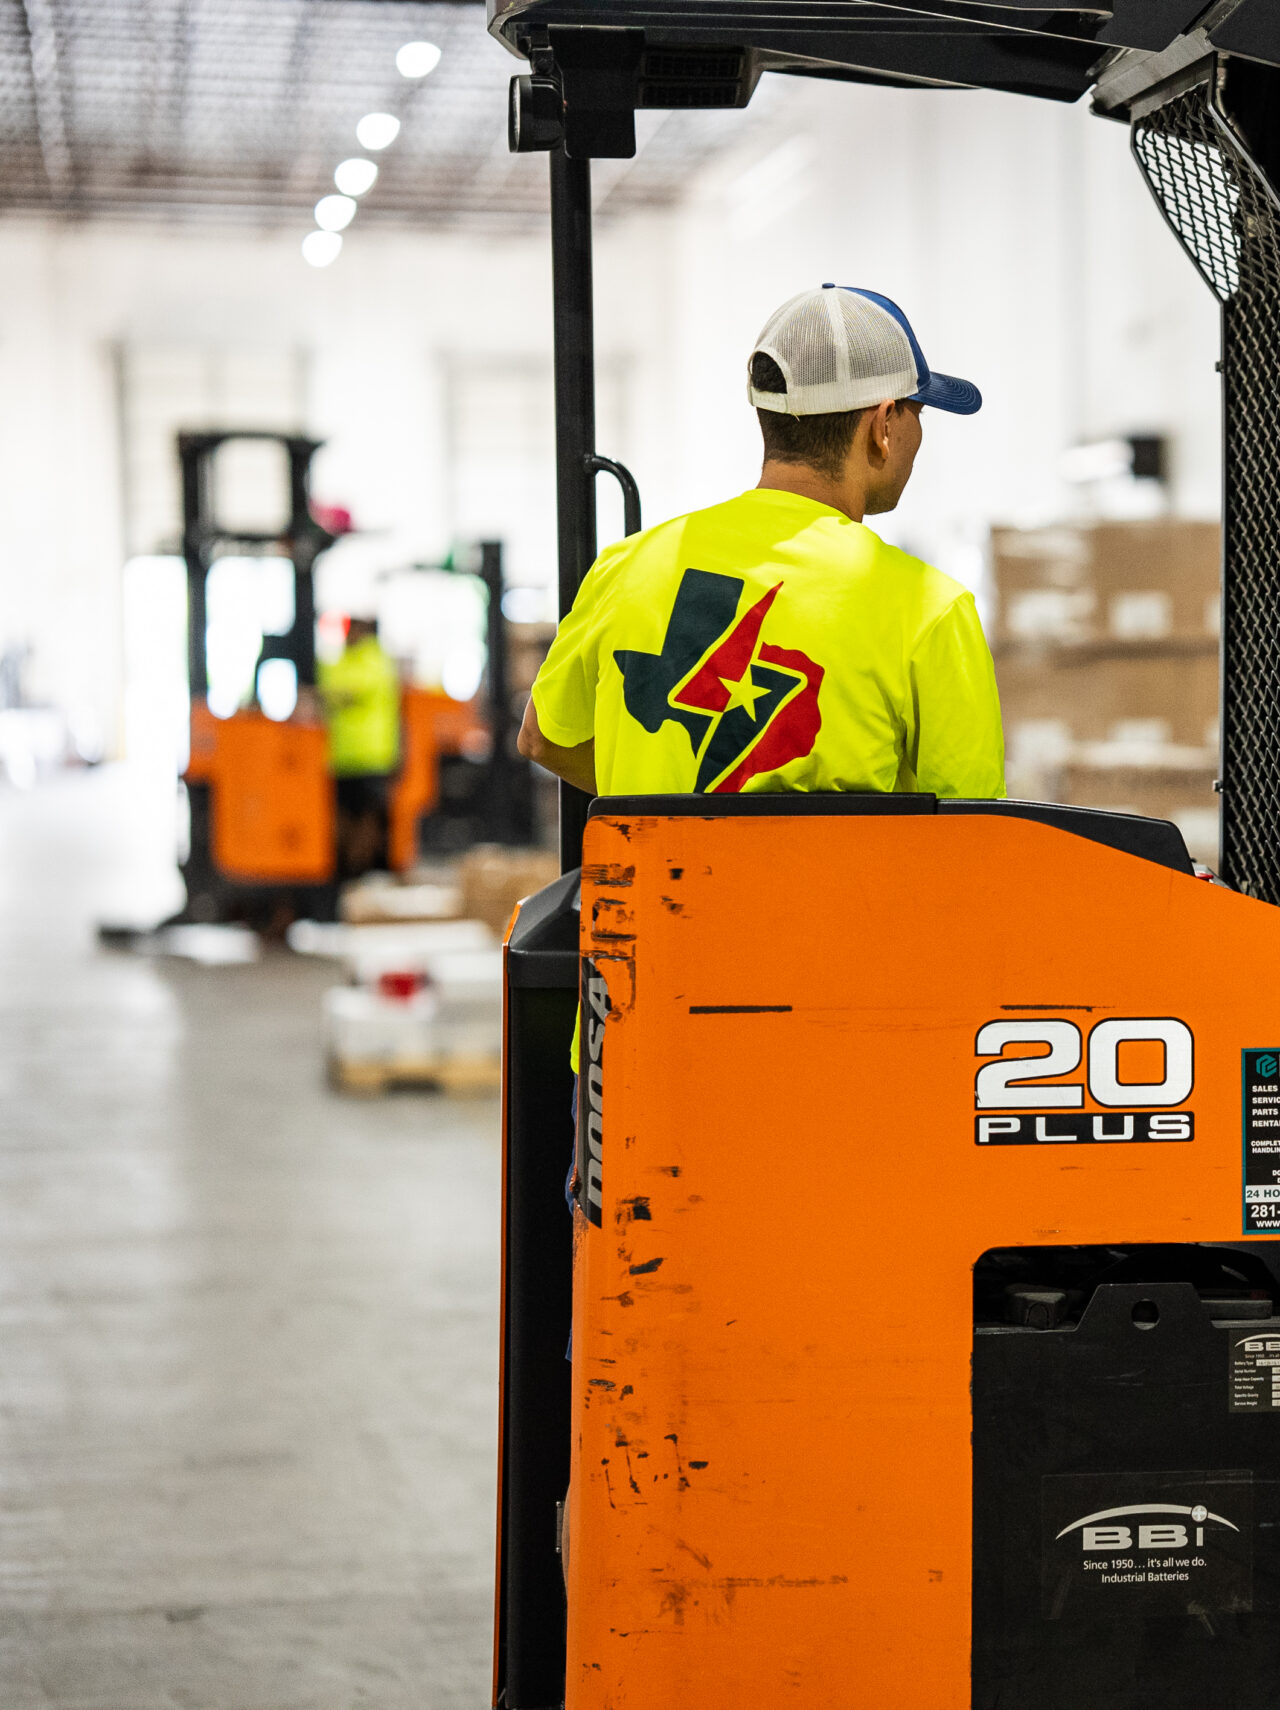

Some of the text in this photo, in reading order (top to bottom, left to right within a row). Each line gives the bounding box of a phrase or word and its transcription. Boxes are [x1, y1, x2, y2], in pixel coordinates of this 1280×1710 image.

[975, 1017, 1194, 1110] 20
[588, 957, 613, 1210] DOOSA
[978, 1114, 1191, 1143] PLUS
[1247, 1190, 1259, 1198] 24
[1084, 1560, 1108, 1570] Since
[1147, 1559, 1161, 1567] it's
[1162, 1558, 1174, 1567] all
[1192, 1557, 1207, 1566] do.
[1102, 1572, 1189, 1583] Industrial Batteries
